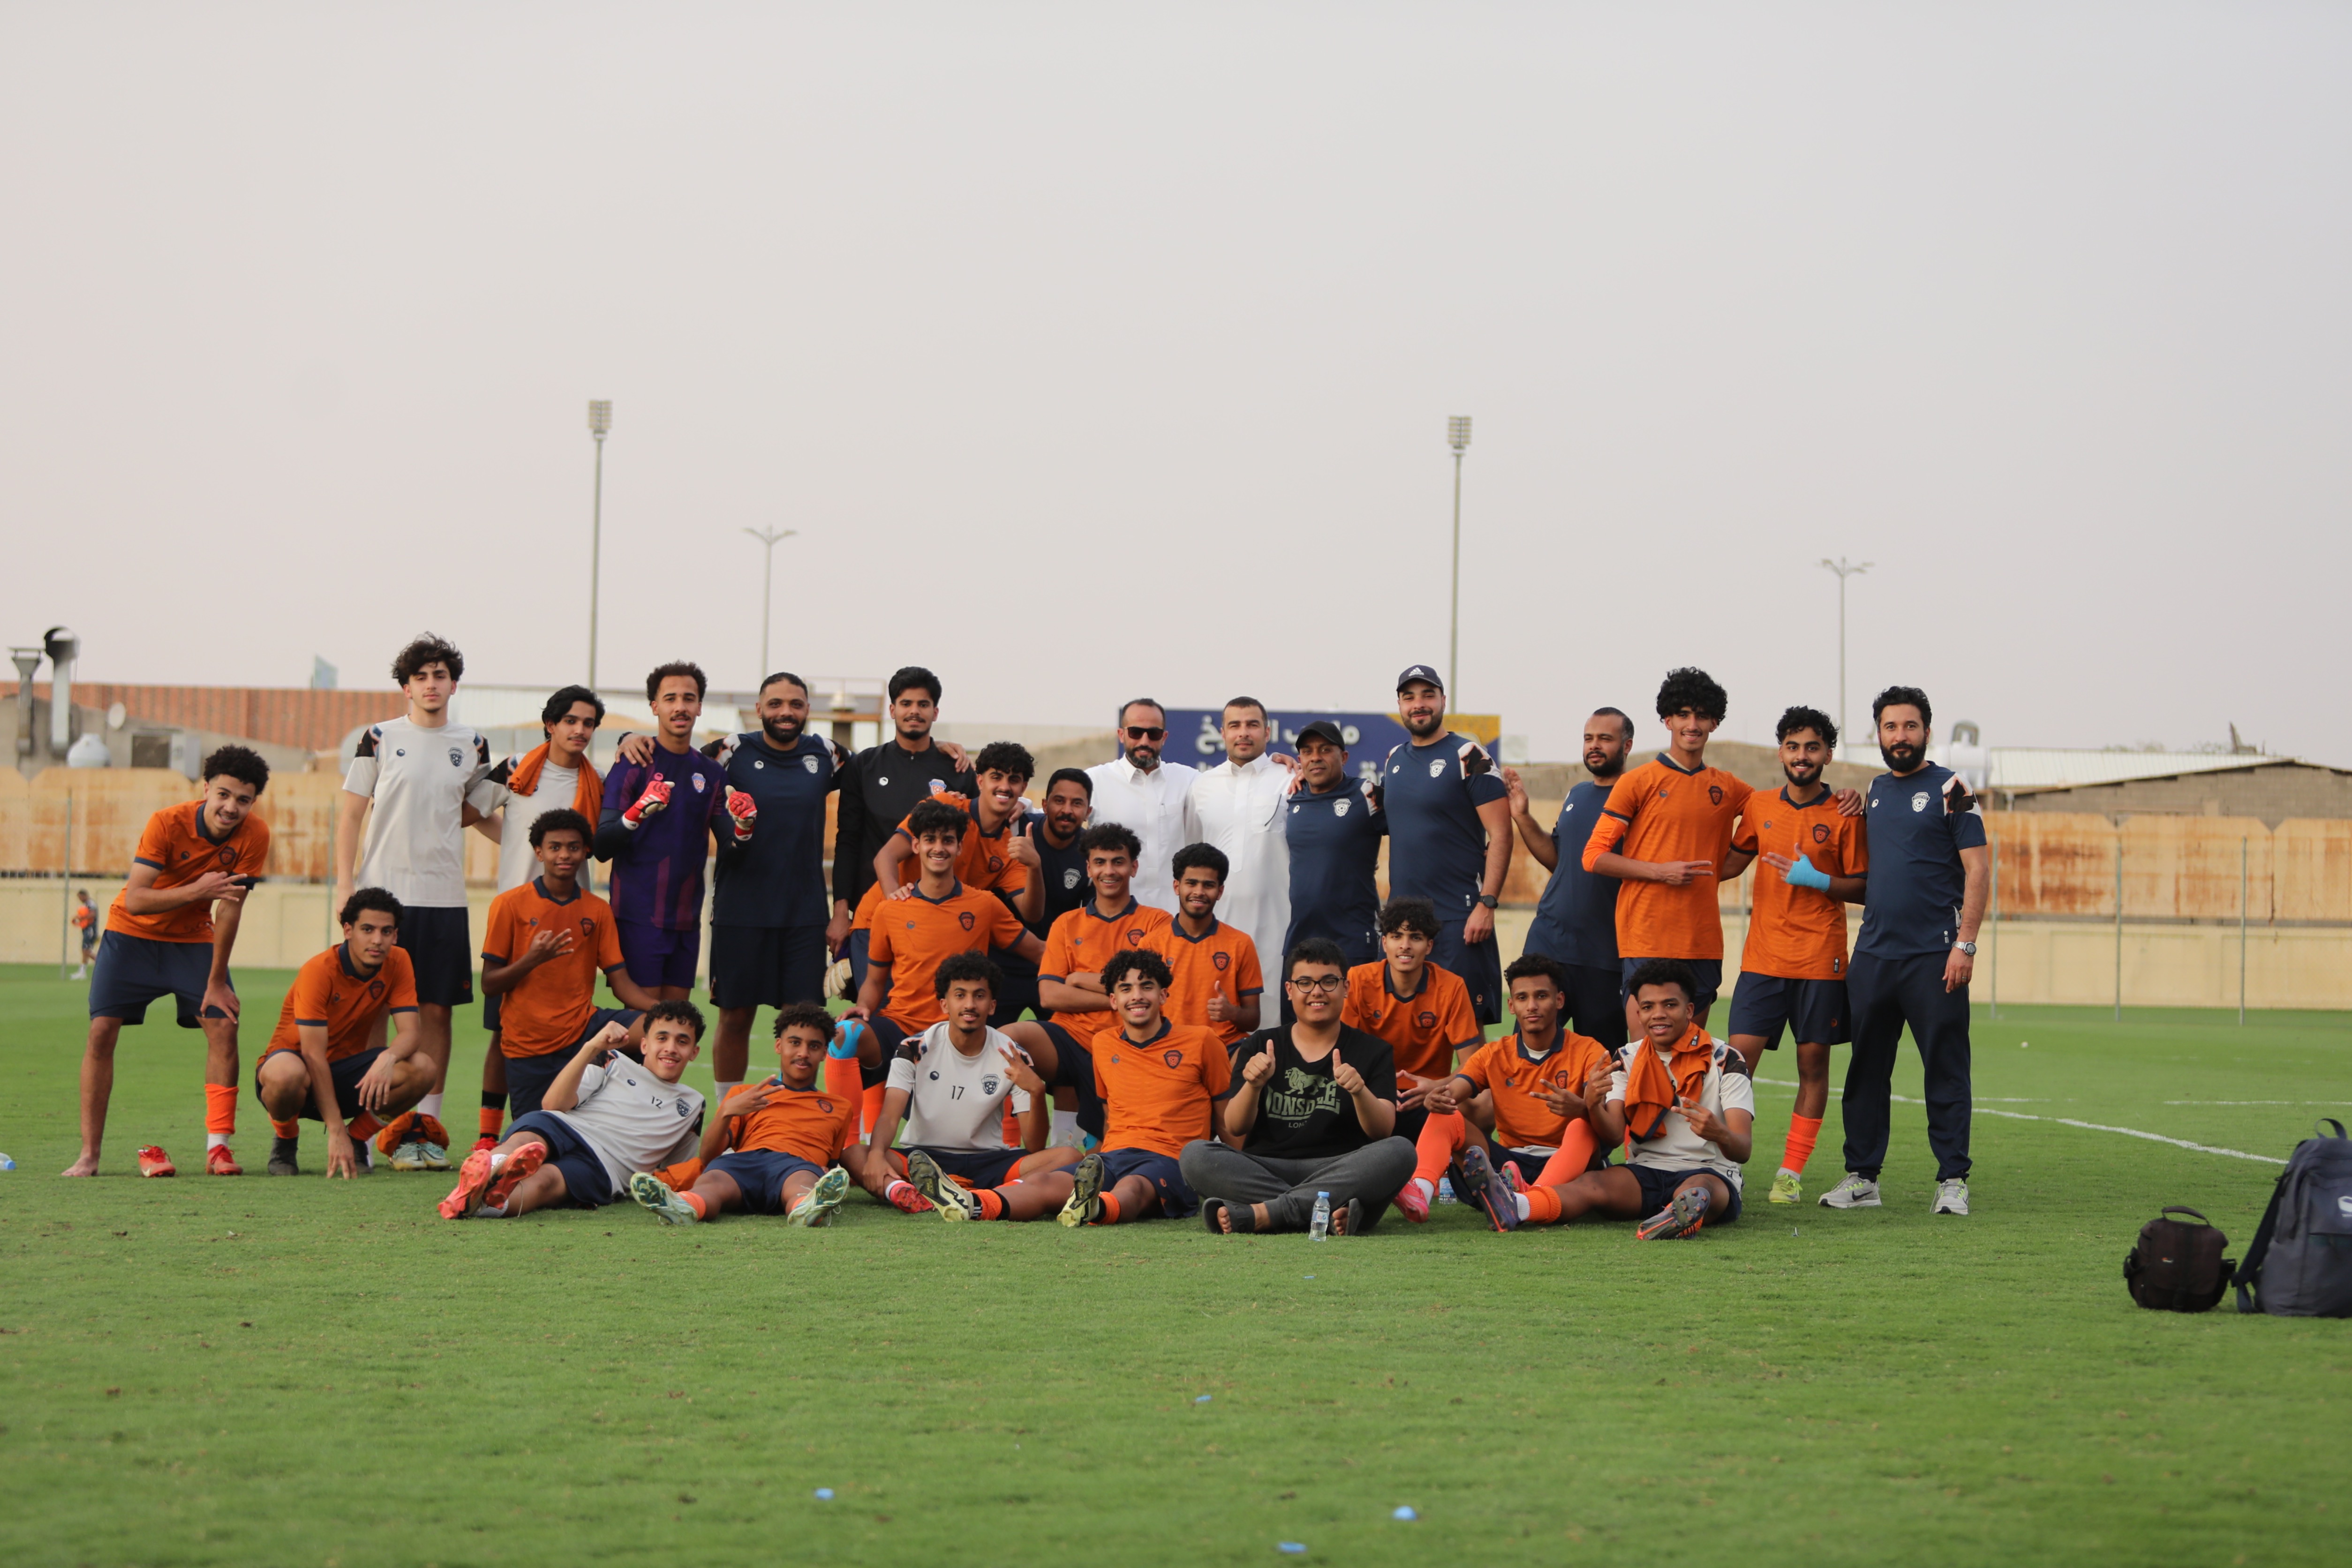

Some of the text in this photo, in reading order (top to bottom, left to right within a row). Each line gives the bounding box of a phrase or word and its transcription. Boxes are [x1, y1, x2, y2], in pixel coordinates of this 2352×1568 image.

[951, 1085, 965, 1100] 17
[1266, 1079, 1337, 1116] LONSDE
[651, 1095, 663, 1109] 12
